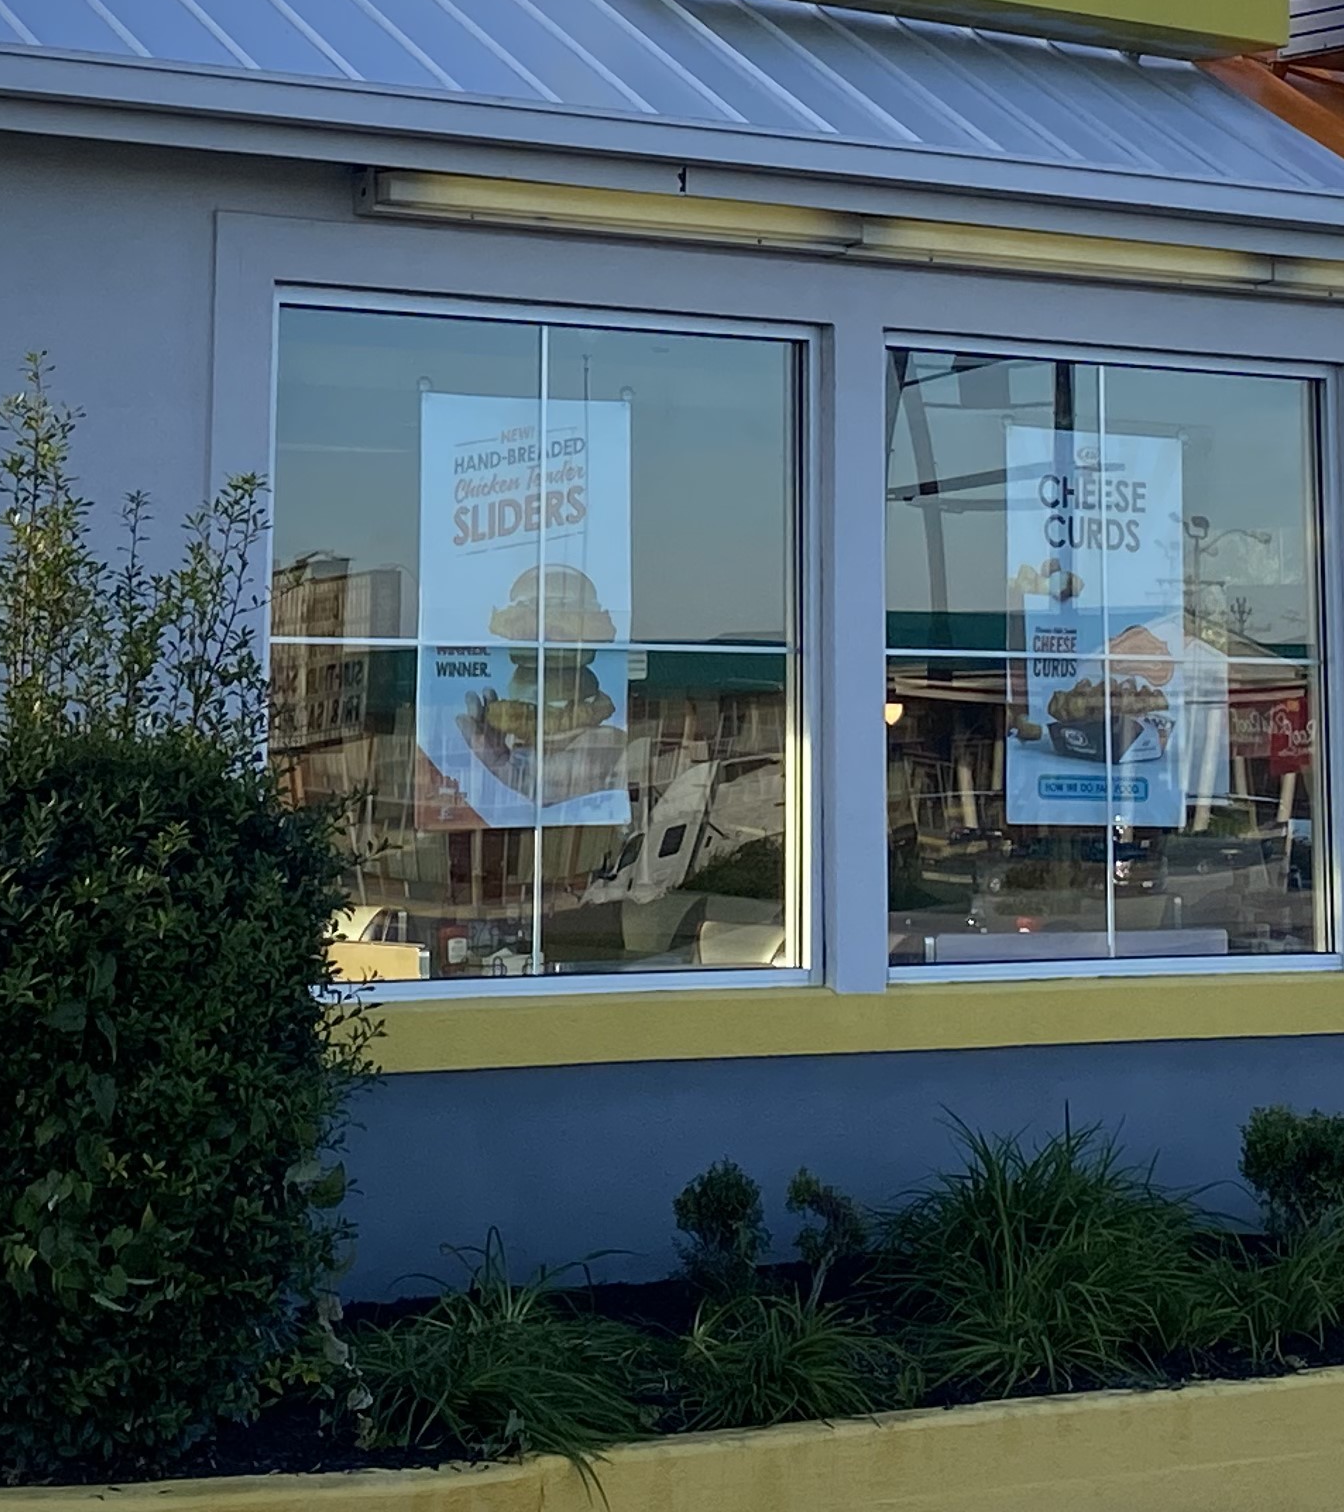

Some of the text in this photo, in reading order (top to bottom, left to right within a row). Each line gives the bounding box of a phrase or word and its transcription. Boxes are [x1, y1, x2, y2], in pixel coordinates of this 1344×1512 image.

[453, 437, 586, 475] HAND-BREADED
[454, 473, 521, 504] Chicken
[1038, 474, 1147, 513] CHEESE
[453, 485, 587, 546] SLIDERS
[1044, 514, 1141, 553] CURDS
[1033, 634, 1077, 653] CHEESE
[1033, 658, 1077, 677] CURDS
